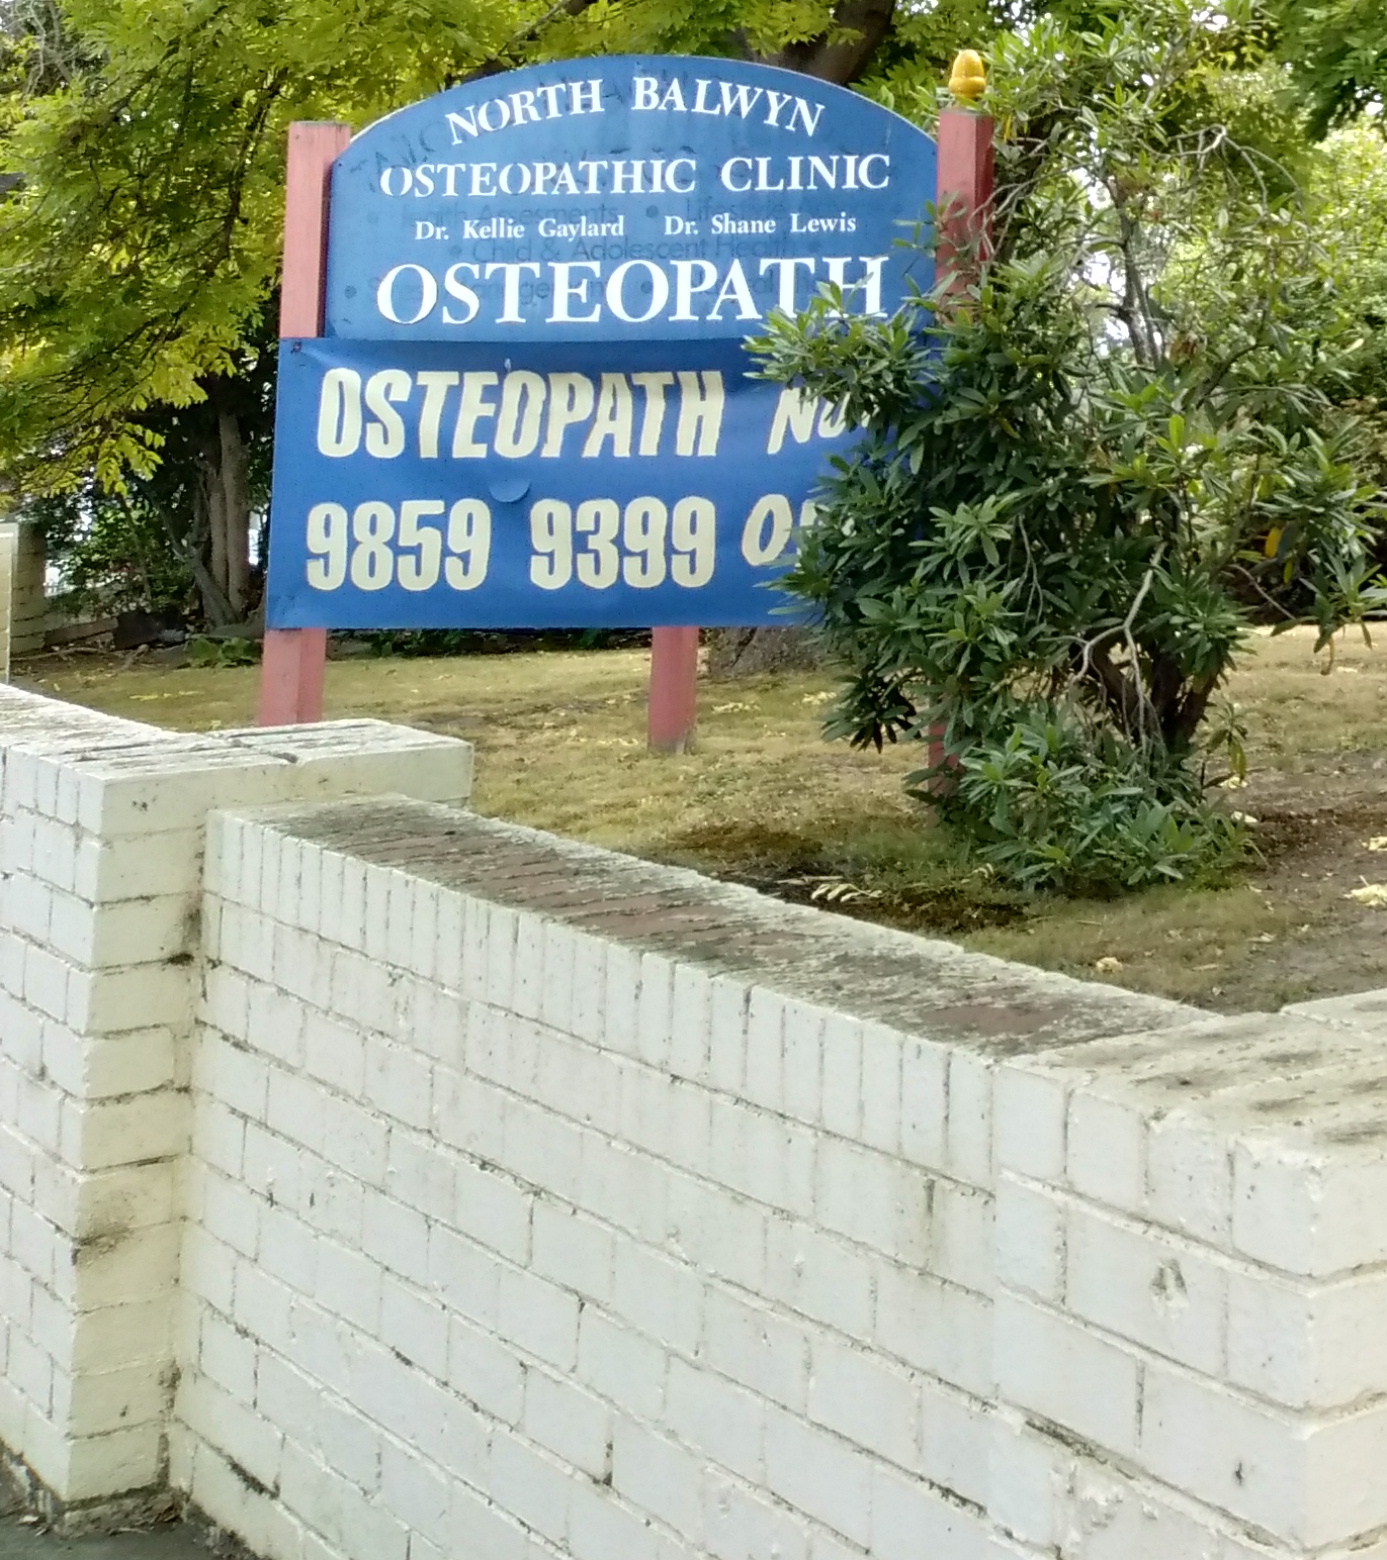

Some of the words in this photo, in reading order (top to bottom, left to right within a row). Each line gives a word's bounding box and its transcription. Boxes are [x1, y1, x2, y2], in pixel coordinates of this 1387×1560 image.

[445, 78, 606, 146] NORTH
[631, 76, 826, 137] BALWYN
[379, 158, 697, 198] OSTEOPATHIC
[720, 153, 891, 192] CLINIC
[414, 221, 450, 240] Dr.
[462, 217, 526, 239] Kellie
[538, 215, 625, 242] Gaylard
[664, 215, 699, 236] Dr.
[711, 212, 776, 234] Shane
[790, 211, 857, 233] Lewis
[376, 256, 890, 325] OSTEOPATH
[316, 367, 726, 459] OSTEOPATH
[306, 498, 492, 591] 9859
[530, 496, 717, 590] 9399
